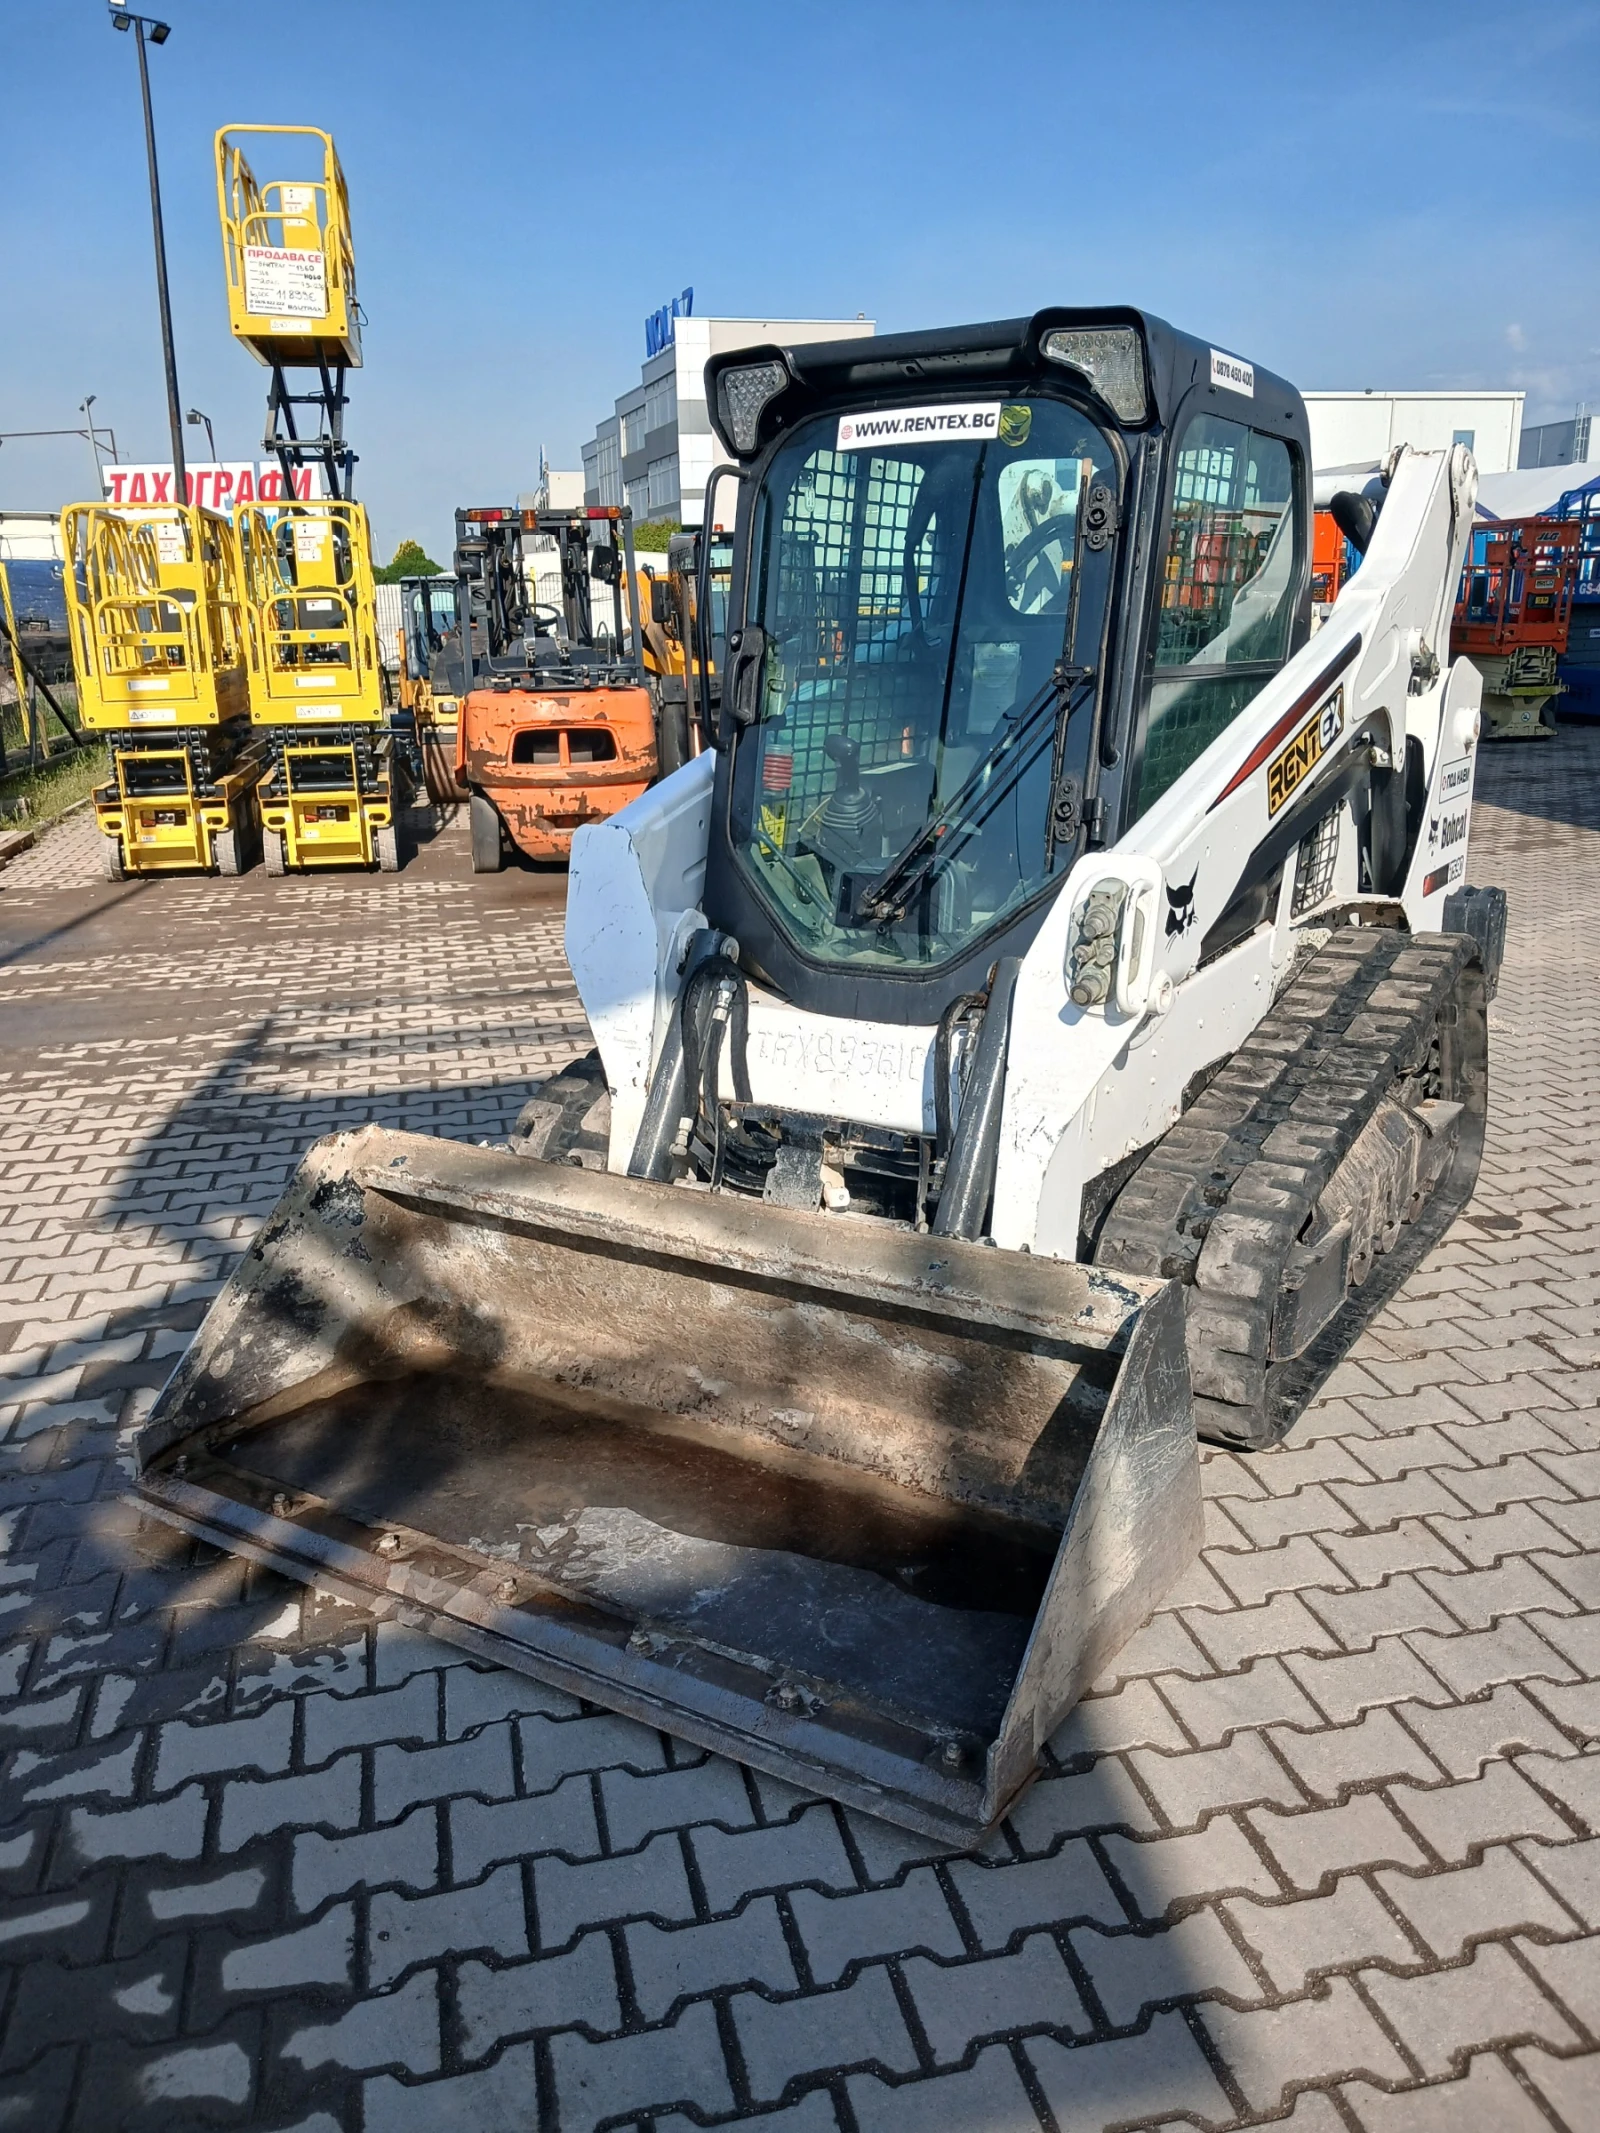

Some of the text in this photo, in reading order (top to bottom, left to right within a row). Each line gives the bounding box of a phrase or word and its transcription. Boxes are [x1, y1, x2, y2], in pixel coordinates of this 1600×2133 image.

[248, 249, 322, 264] ПРОДАВА СЕ
[1231, 366, 1241, 382] 450
[1242, 371, 1252, 387] 400
[855, 412, 996, 438] WWW.RENTEX.BG
[1536, 531, 1560, 541] JLG
[1271, 694, 1342, 810] RENTEX
[1441, 808, 1468, 850] Bobcat
